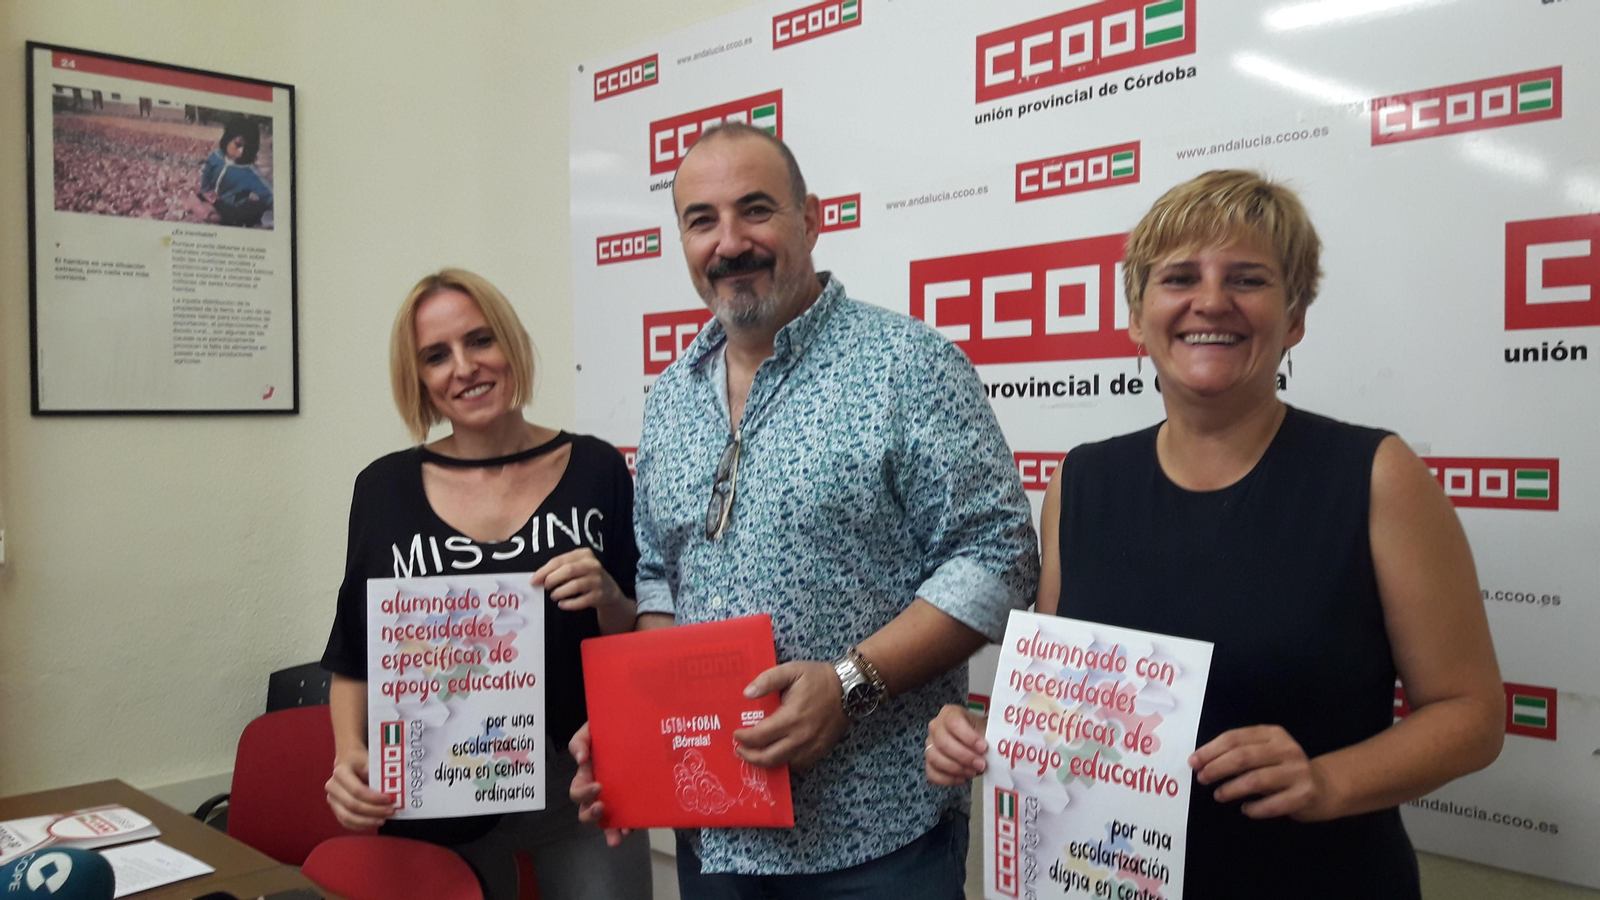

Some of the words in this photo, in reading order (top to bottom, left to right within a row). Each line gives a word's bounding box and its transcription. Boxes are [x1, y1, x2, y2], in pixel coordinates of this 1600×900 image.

[61, 57, 76, 69] 24
[984, 9, 1136, 87] CCOO
[596, 65, 643, 96] CCOO
[974, 105, 1013, 125] unión
[1018, 86, 1093, 118] provincial
[1098, 78, 1118, 97] de
[1124, 65, 1197, 92] Córdoba
[1379, 85, 1512, 136] CCOO
[1176, 125, 1329, 160] www.andalucia.ccoo.es
[1020, 155, 1108, 194] CCOO
[885, 185, 989, 210] www.andalucia.ccoo.es
[599, 234, 645, 260] CCOO
[1504, 340, 1588, 363] unión
[1109, 373, 1144, 395] de
[381, 588, 480, 615] alumnado
[488, 591, 520, 611] con
[381, 615, 494, 643] necesidades
[381, 645, 482, 675] específicas
[489, 641, 513, 664] de
[1016, 629, 1127, 673] alumnado
[1135, 657, 1175, 687] con
[381, 679, 441, 704] apoyo
[448, 669, 537, 694] educativo
[1009, 668, 1137, 716] necesidades
[486, 715, 507, 735] por
[511, 714, 535, 729] una
[1004, 703, 1116, 748] específicas
[1124, 721, 1154, 755] de
[452, 734, 535, 756] escolarización
[672, 733, 711, 751] ¡Bórrala!
[408, 719, 423, 809] enseñanza
[434, 761, 471, 786] digna
[476, 764, 490, 779] en
[494, 759, 535, 778] centros
[997, 737, 1061, 777] apoyo
[1069, 749, 1179, 798] educativo
[475, 783, 535, 802] ordinarios
[1111, 818, 1137, 845] por
[1142, 828, 1172, 851] una
[1069, 839, 1169, 884] escolarización
[1049, 858, 1090, 894] digna
[1095, 878, 1112, 899] en
[1117, 884, 1168, 900] centr
